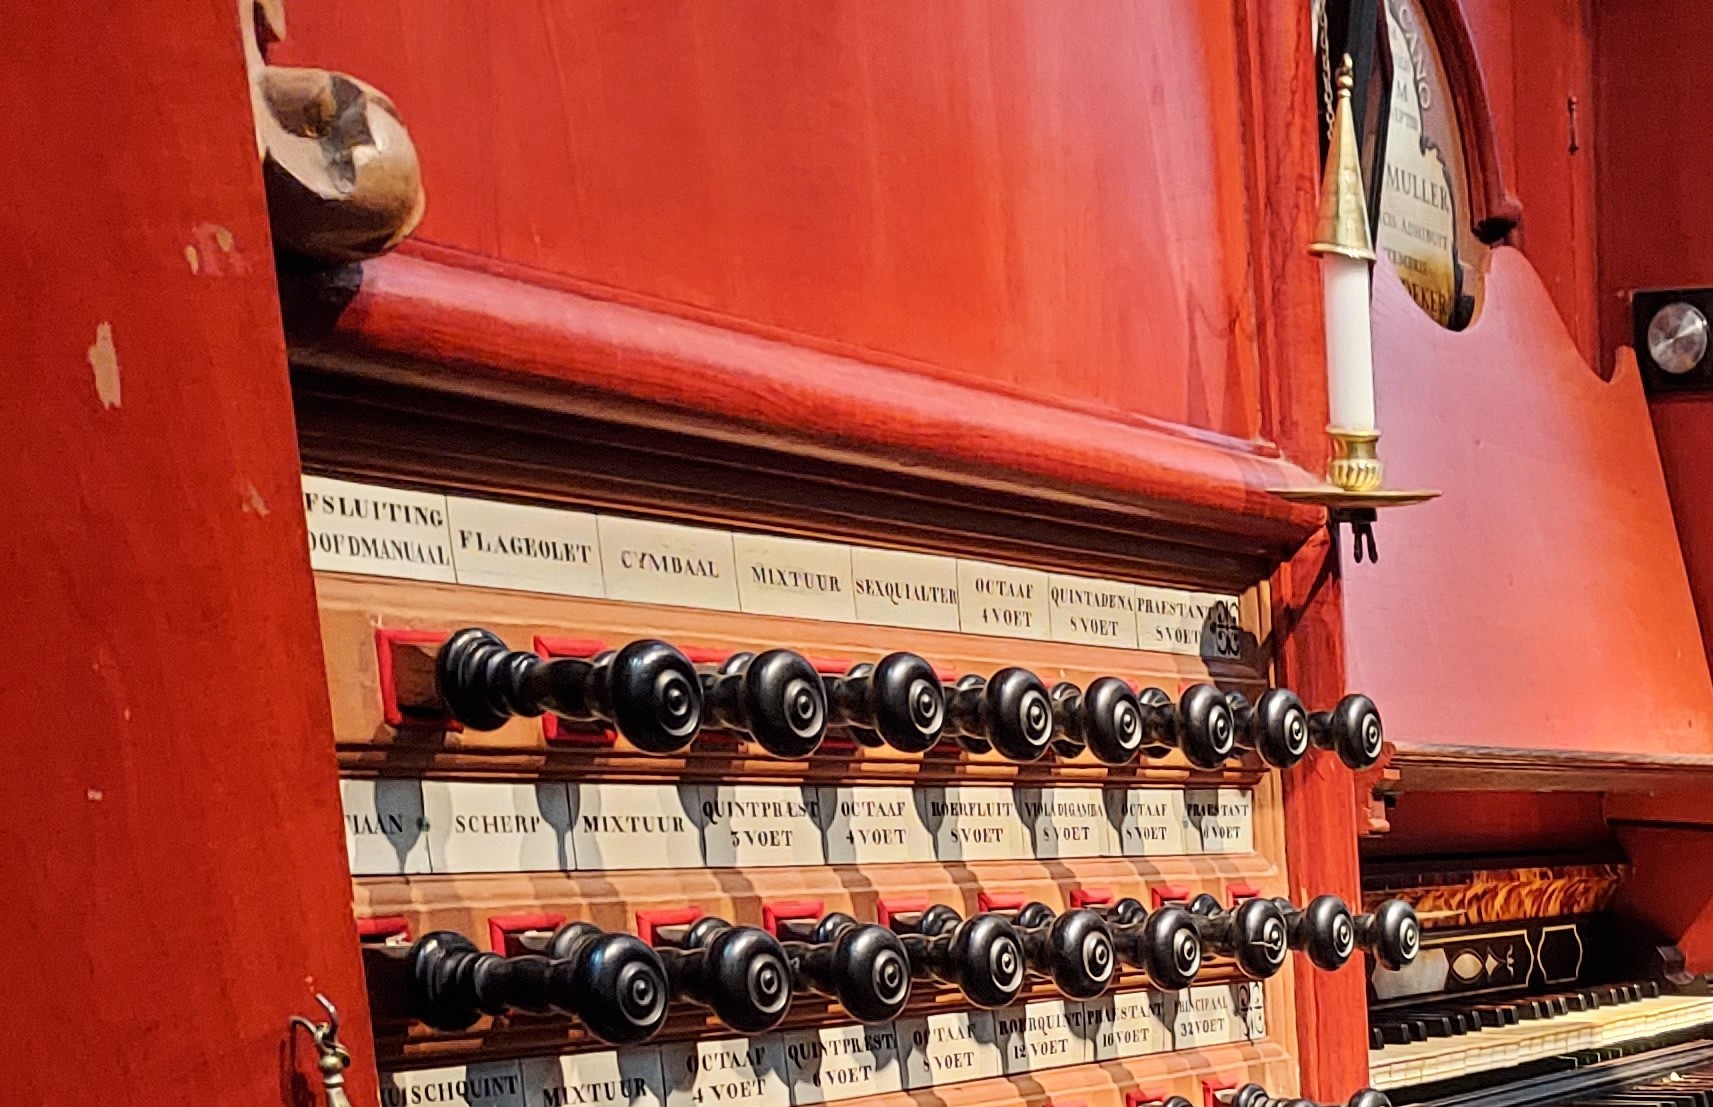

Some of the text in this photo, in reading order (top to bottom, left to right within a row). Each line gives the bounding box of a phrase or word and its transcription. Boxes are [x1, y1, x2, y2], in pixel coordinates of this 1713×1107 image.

[1386, 163, 1450, 213] MULLER
[305, 492, 443, 527] FSLUITING
[459, 530, 593, 565] FLAGEOLET
[621, 550, 721, 579] CYMBAAL
[751, 566, 842, 593] MIXTUUR
[975, 577, 1034, 599] OCTAAF
[855, 579, 957, 605] SEXQUIALTER
[1050, 586, 1133, 611] QUINTADENA
[983, 608, 1032, 628] 4 VOET
[1080, 617, 1119, 637] VOET
[1166, 626, 1200, 645] VOET
[841, 801, 906, 817] OCTAAF
[1121, 803, 1168, 817] OCTAAF
[455, 814, 541, 835] SCHERP
[582, 814, 686, 834] MIXTUUR
[1053, 826, 1090, 841] VOET
[1136, 826, 1168, 841] VOET
[1211, 826, 1241, 839] VOET
[744, 830, 793, 847] VOET
[846, 829, 907, 845] 4 VOET
[961, 828, 1004, 843] VOET
[913, 1024, 976, 1046] OCTAAF
[1115, 1028, 1150, 1044] VOET
[1180, 1018, 1225, 1037] 32 VOET
[1013, 1038, 1069, 1059] 12 VOET
[686, 1047, 765, 1074] OCTAAF
[933, 1052, 975, 1070] VOET
[825, 1065, 872, 1086] VOET
[692, 1079, 767, 1103] 4 VOET
